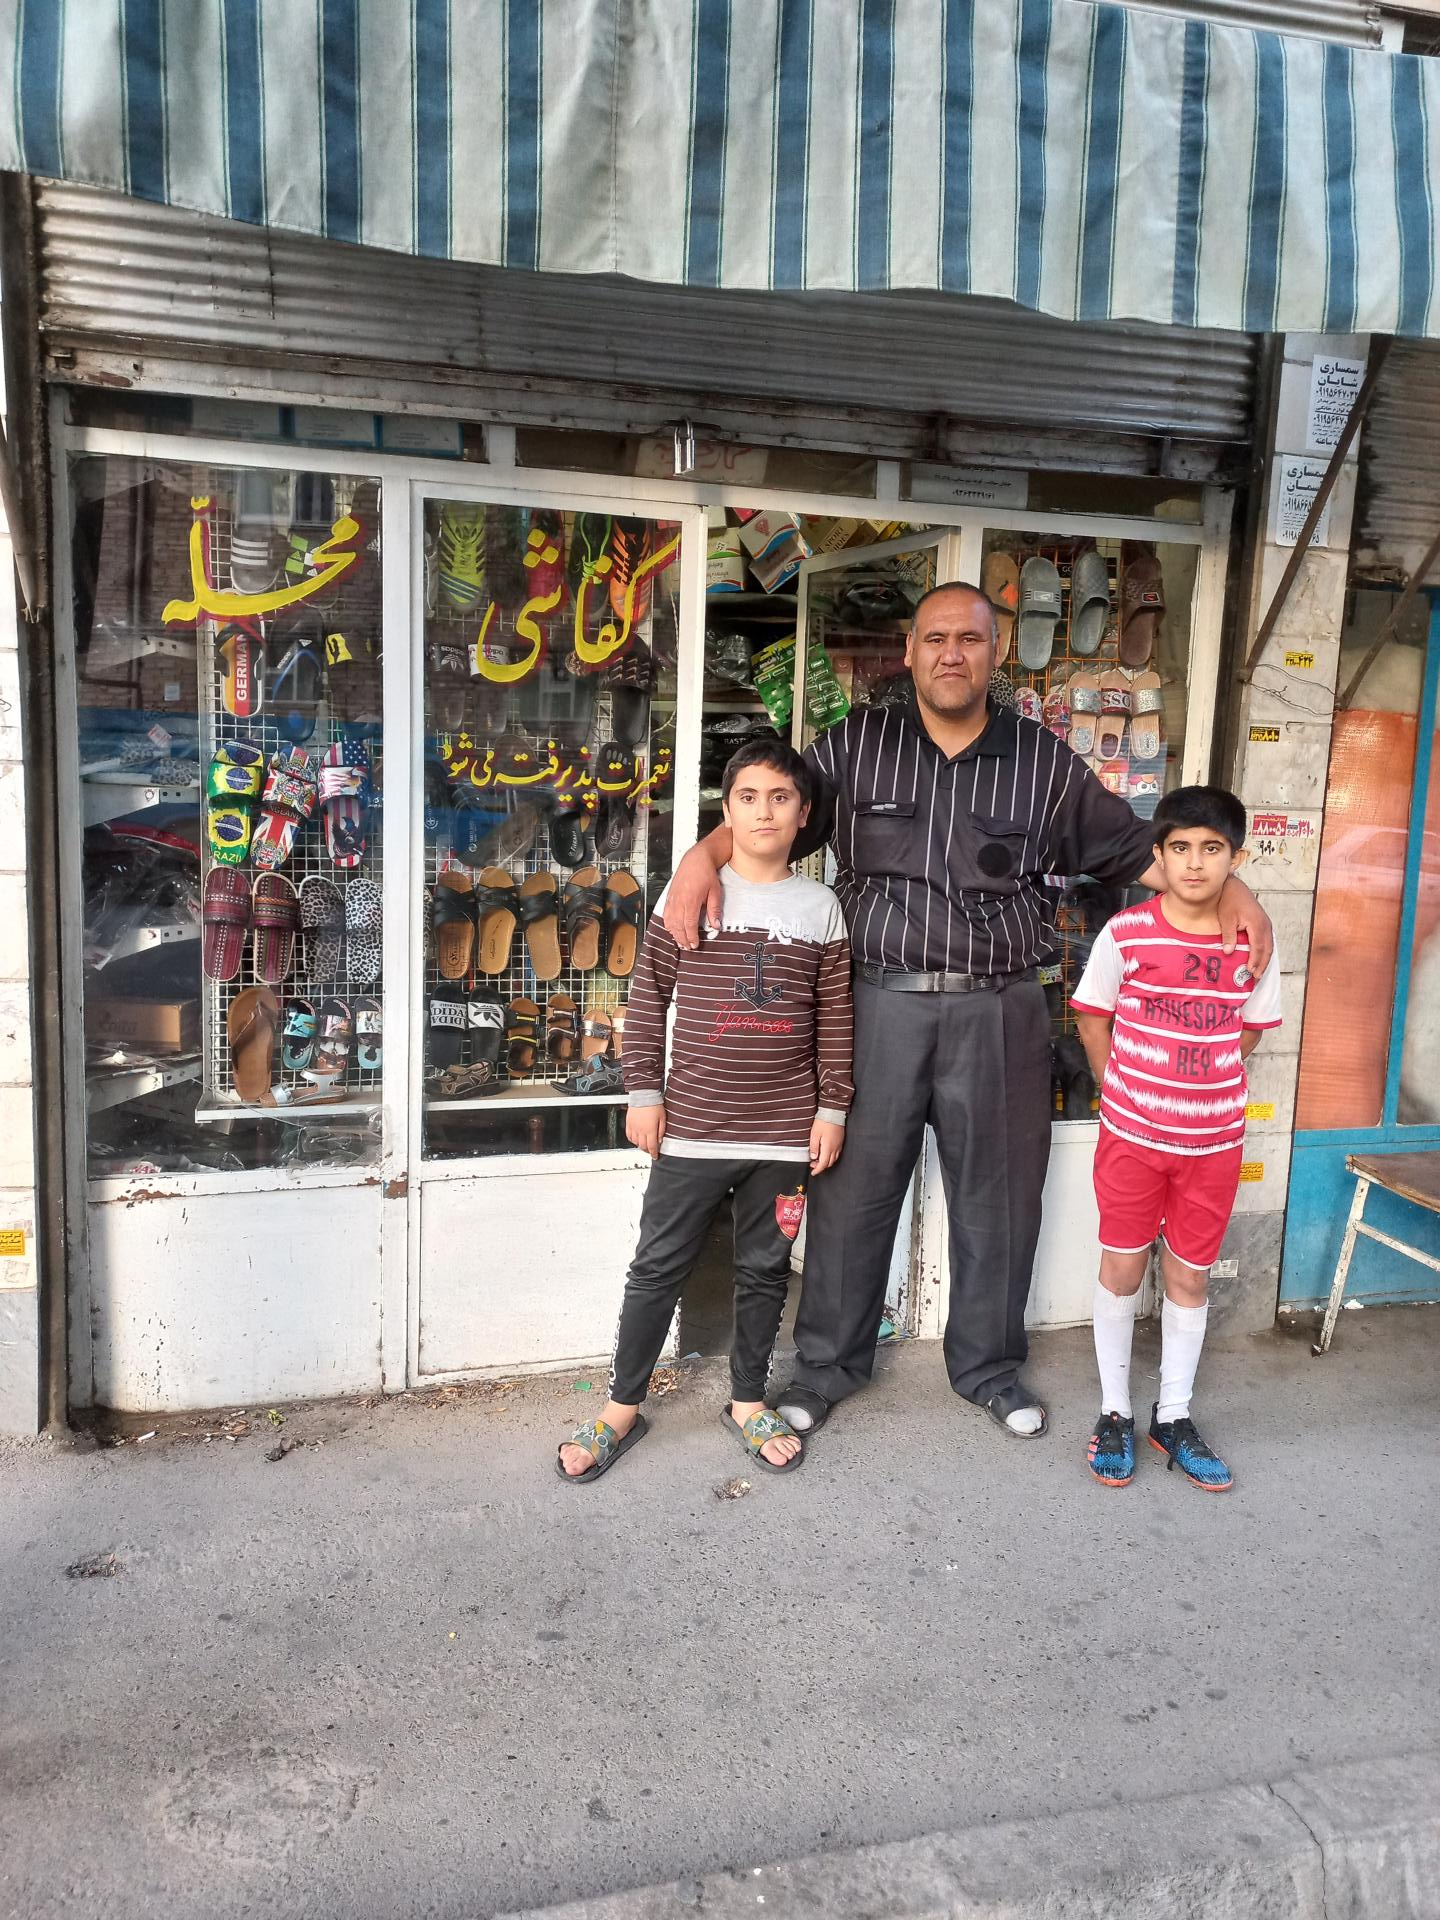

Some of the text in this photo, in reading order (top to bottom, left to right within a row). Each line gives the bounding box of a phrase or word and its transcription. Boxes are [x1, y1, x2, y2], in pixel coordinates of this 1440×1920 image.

[1317, 375, 1358, 388] شایان
[1320, 362, 1359, 374] سمساری
[477, 528, 681, 683] کفاشی
[597, 748, 671, 805] تعمیرات
[1183, 954, 1222, 984] 28
[1176, 1046, 1211, 1077] REY
